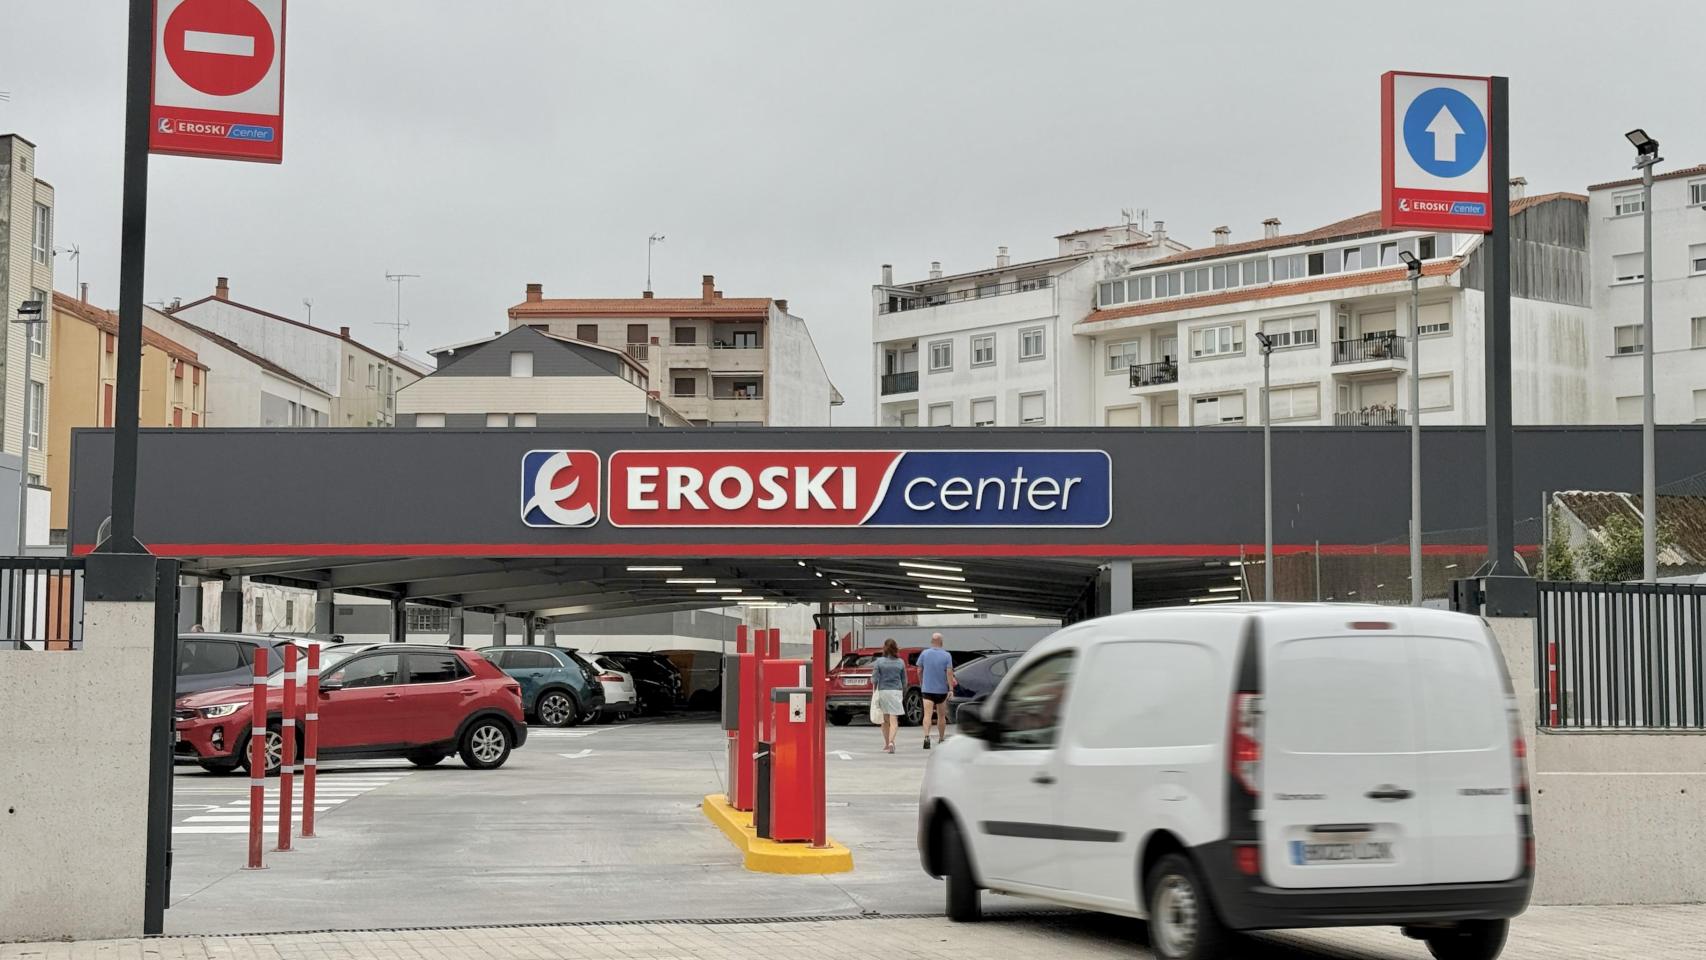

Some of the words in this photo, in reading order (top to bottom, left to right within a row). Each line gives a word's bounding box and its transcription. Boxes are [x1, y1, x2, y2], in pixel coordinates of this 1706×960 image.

[178, 122, 224, 135] EROSKI
[232, 128, 268, 138] center
[1413, 201, 1448, 211] EROSKI
[1454, 204, 1481, 213] center
[626, 466, 857, 511] EROSKI
[904, 466, 1082, 511] center
